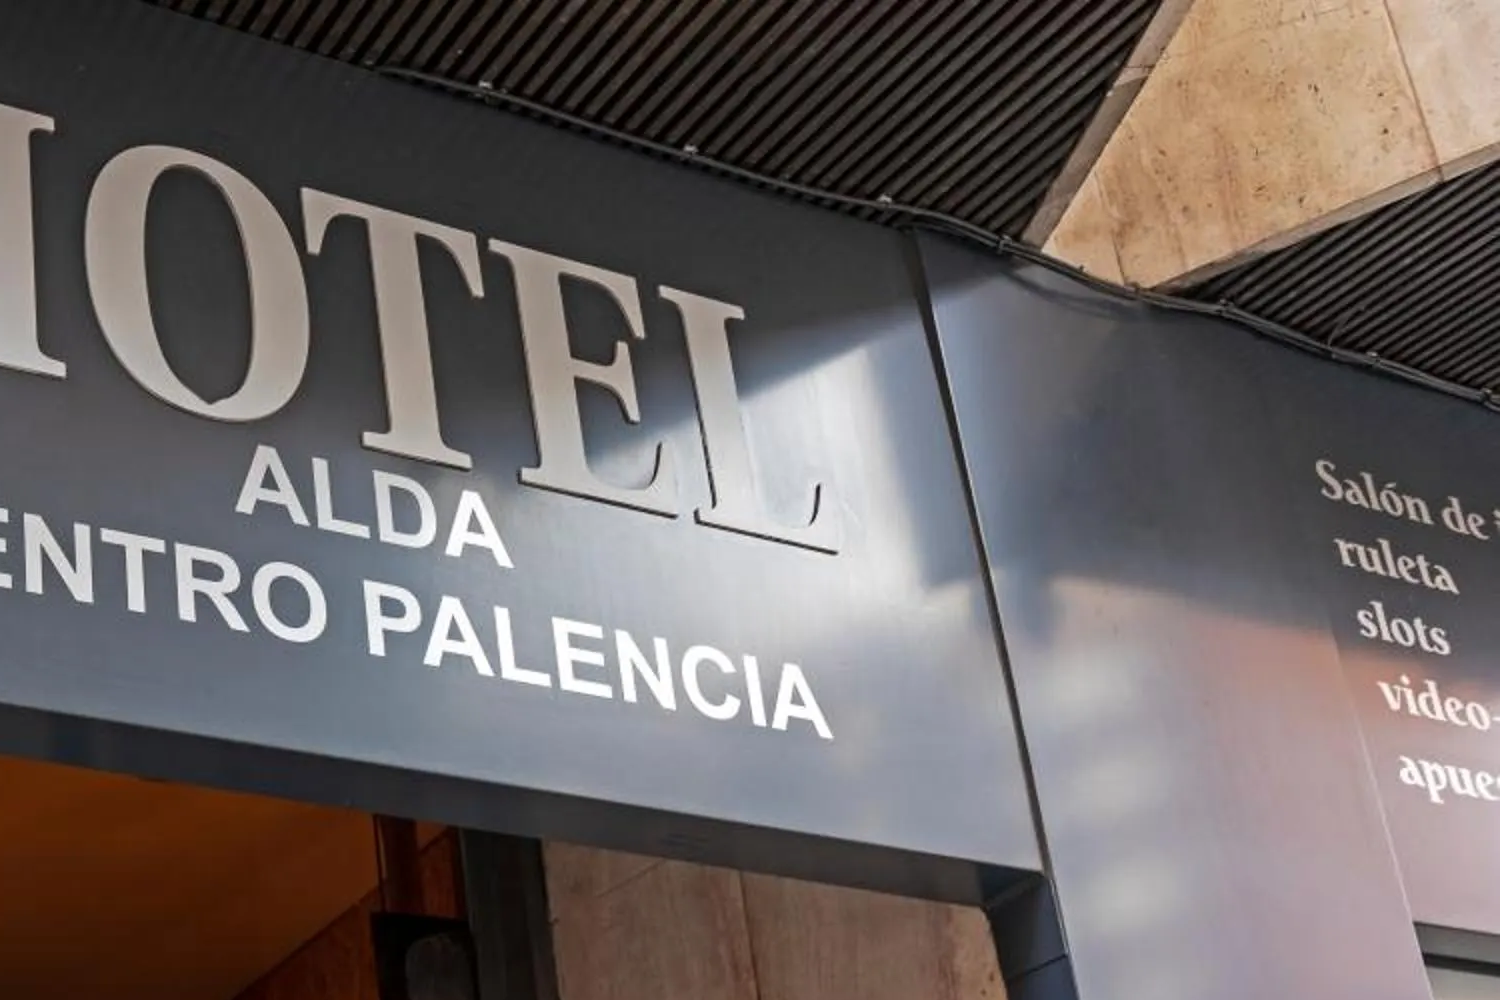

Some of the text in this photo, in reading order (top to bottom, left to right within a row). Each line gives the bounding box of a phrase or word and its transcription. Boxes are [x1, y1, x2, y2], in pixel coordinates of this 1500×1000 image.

[234, 443, 515, 570] ALDA
[1315, 458, 1434, 525] Salón
[1441, 496, 1489, 541] de
[1334, 537, 1460, 595] ruleta
[362, 578, 834, 740] PALENCIA
[1356, 601, 1451, 655] slots
[1399, 754, 1500, 805] apue
